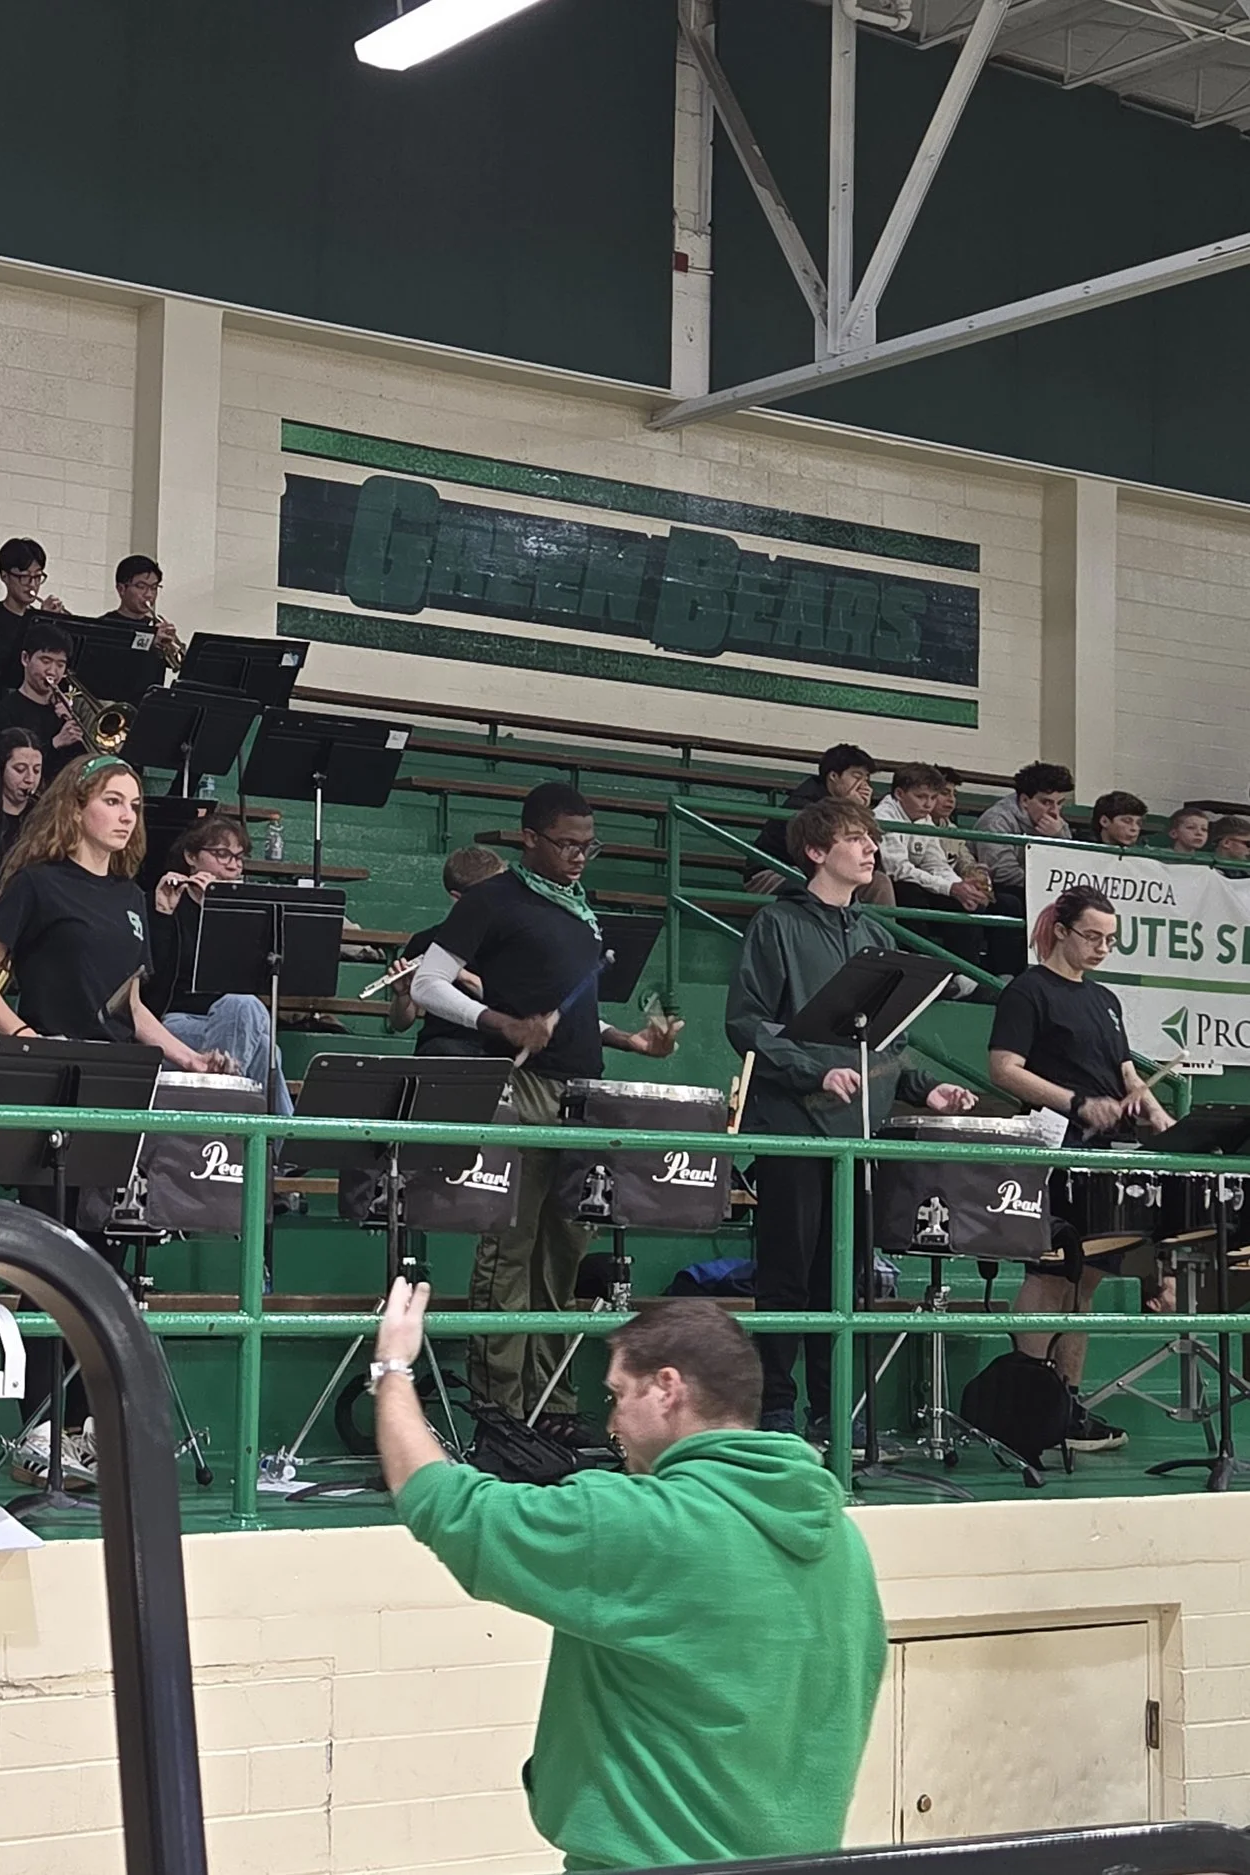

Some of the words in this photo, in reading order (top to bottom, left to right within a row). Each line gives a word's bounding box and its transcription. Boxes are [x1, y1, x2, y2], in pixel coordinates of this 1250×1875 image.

[649, 525, 928, 663] BEARS
[1046, 869, 1177, 906] PROMEDICA
[1115, 914, 1204, 962] UTES
[190, 1141, 244, 1181] Pea
[652, 1151, 717, 1185] Pearl
[986, 1180, 1042, 1216] Pearl
